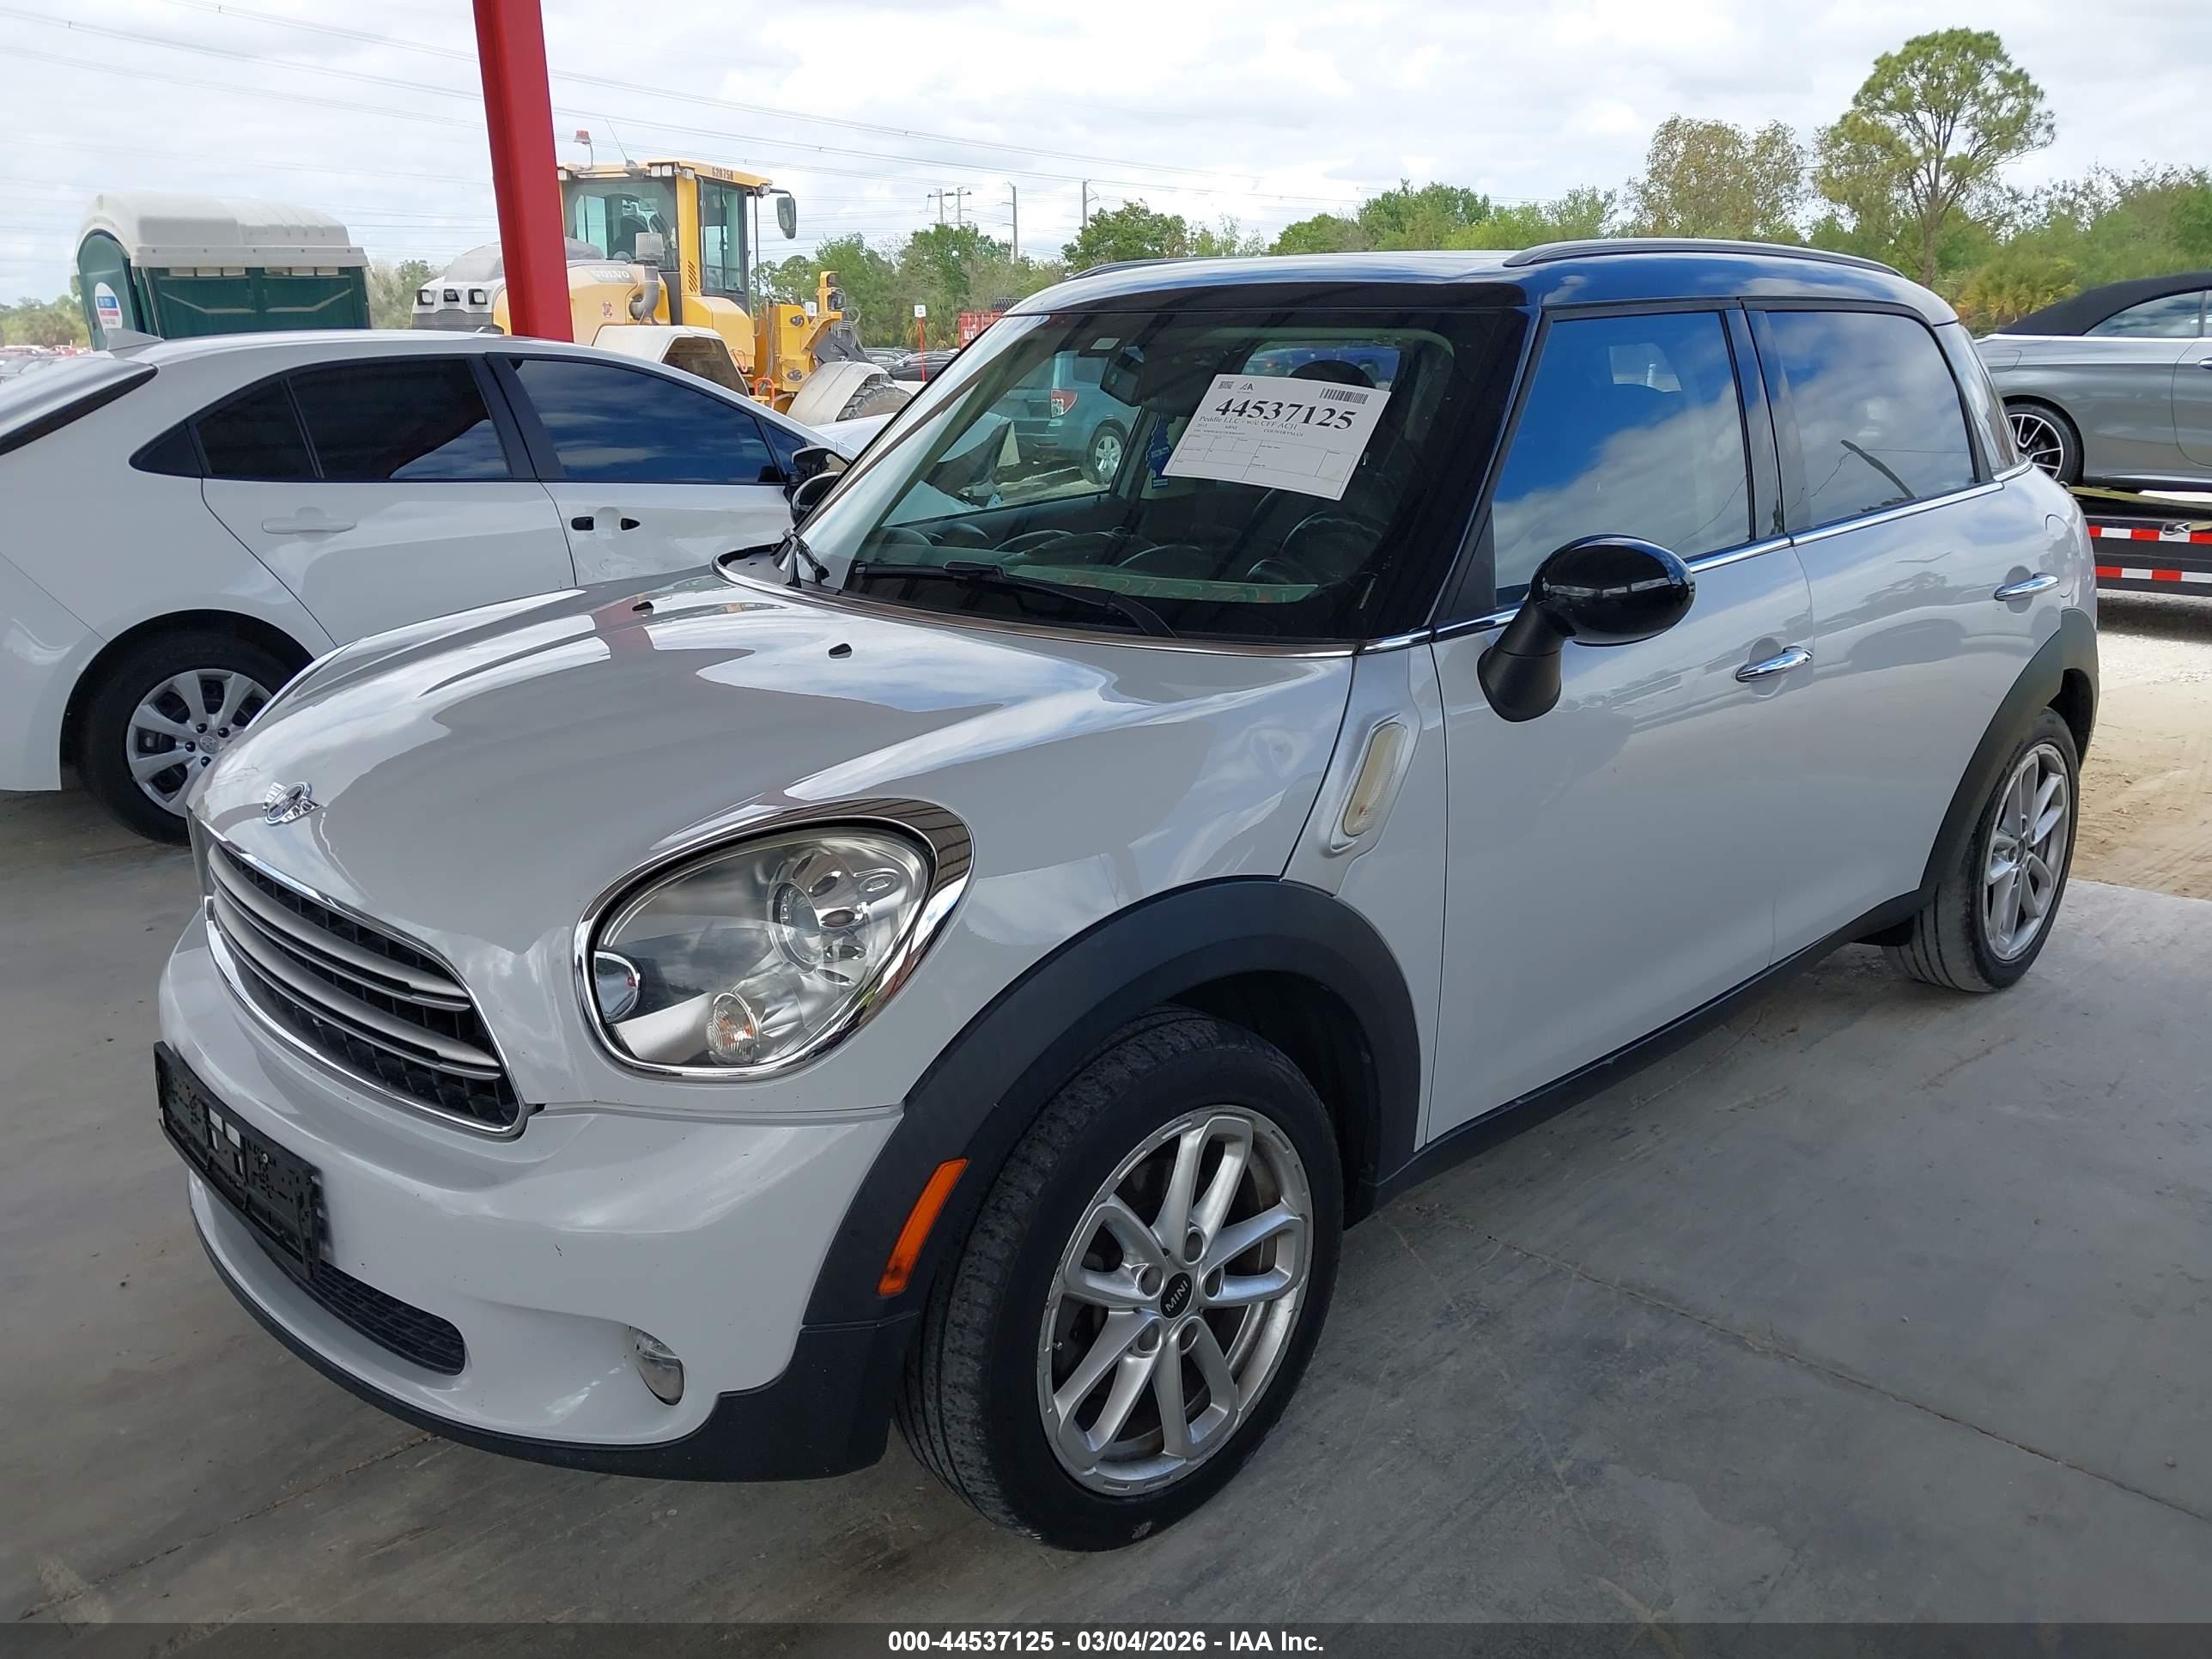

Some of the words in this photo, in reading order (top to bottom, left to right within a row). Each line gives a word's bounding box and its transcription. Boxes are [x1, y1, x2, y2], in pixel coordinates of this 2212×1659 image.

[591, 270, 630, 279] VOLVO
[1215, 398, 1358, 430] 44537125
[1224, 416, 1241, 425] LLC
[1164, 1279, 1188, 1312] MINI
